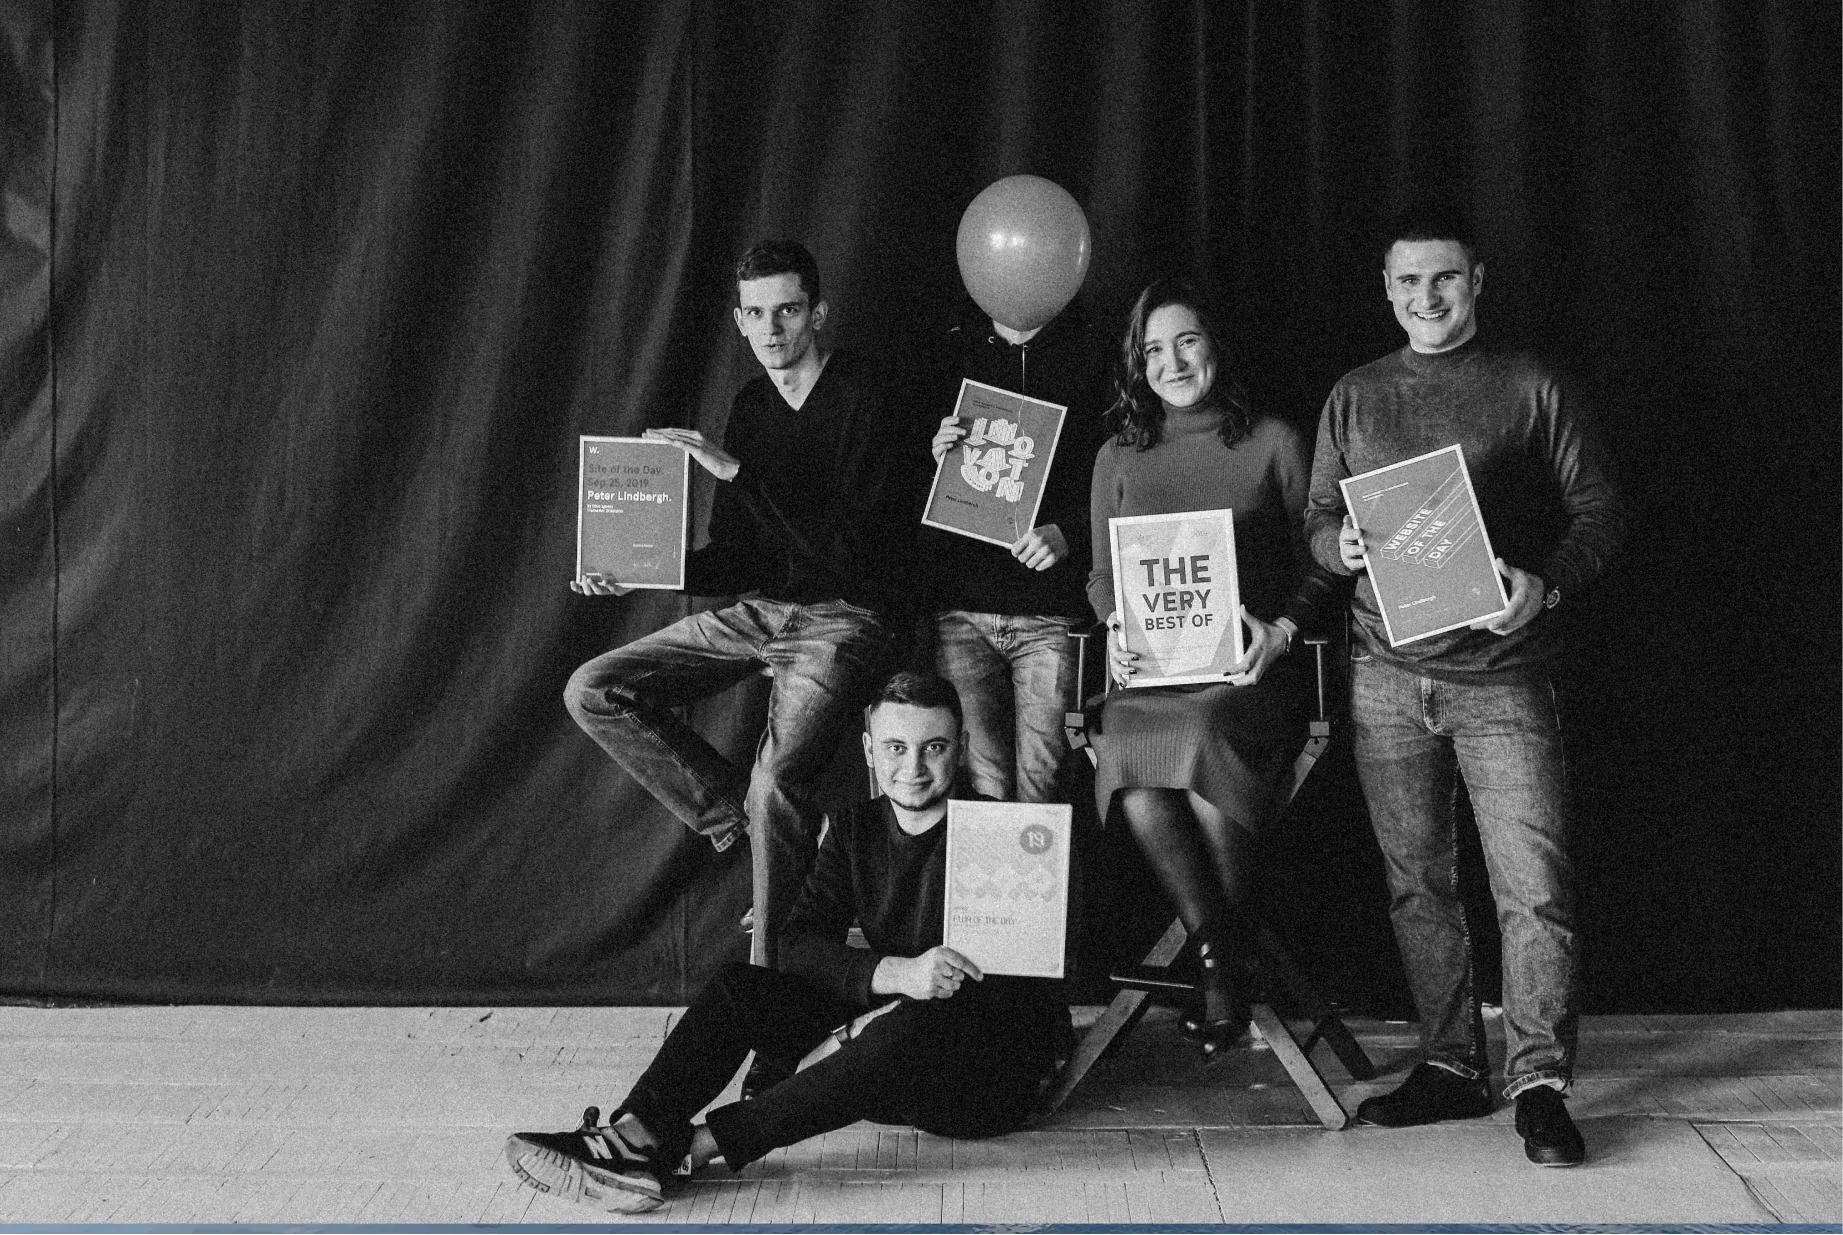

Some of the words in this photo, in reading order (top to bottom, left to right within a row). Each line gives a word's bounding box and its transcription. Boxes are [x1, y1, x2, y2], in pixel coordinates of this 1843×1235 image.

[589, 446, 599, 454] W.
[588, 463, 607, 474] Site
[610, 465, 620, 474] of
[623, 465, 640, 475] the
[643, 465, 664, 476] Day.
[587, 477, 606, 489] Sep
[587, 490, 615, 501] Peter
[618, 490, 672, 504] Lindbergh.
[1383, 508, 1433, 550] WEBSITE
[1407, 540, 1425, 555] OF
[1421, 520, 1447, 538] THE
[1427, 538, 1453, 560] DAY
[1139, 555, 1211, 587] THE
[1142, 588, 1211, 613] VERY
[1145, 616, 1185, 631] BEST
[1191, 613, 1214, 628] OF
